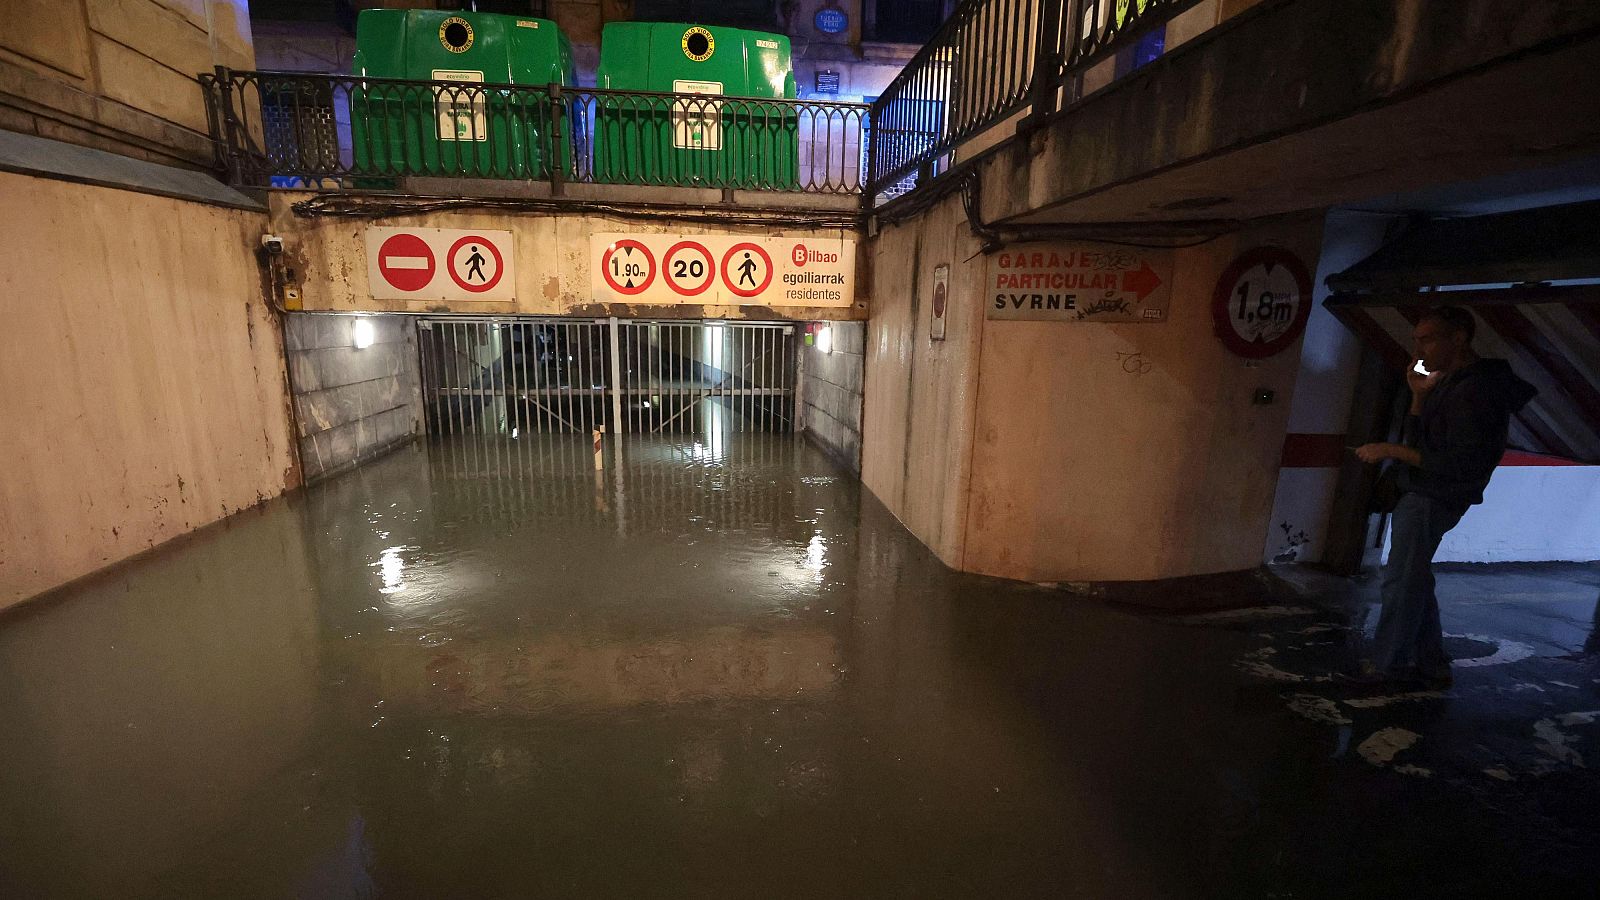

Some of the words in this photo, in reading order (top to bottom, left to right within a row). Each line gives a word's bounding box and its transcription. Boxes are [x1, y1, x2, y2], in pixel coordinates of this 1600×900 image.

[440, 18, 454, 31] SOLO
[456, 17, 473, 35] VIDRIO
[683, 28, 696, 41] SOLO
[697, 27, 714, 43] VIDRIO
[794, 249, 838, 264] Bilbao
[998, 252, 1090, 269] GARAJE
[612, 257, 646, 277] 1.90m
[674, 259, 704, 278] 20
[783, 271, 846, 286] egoiliarrak
[996, 273, 1119, 289] PARTICULAR
[786, 287, 841, 301] residentes
